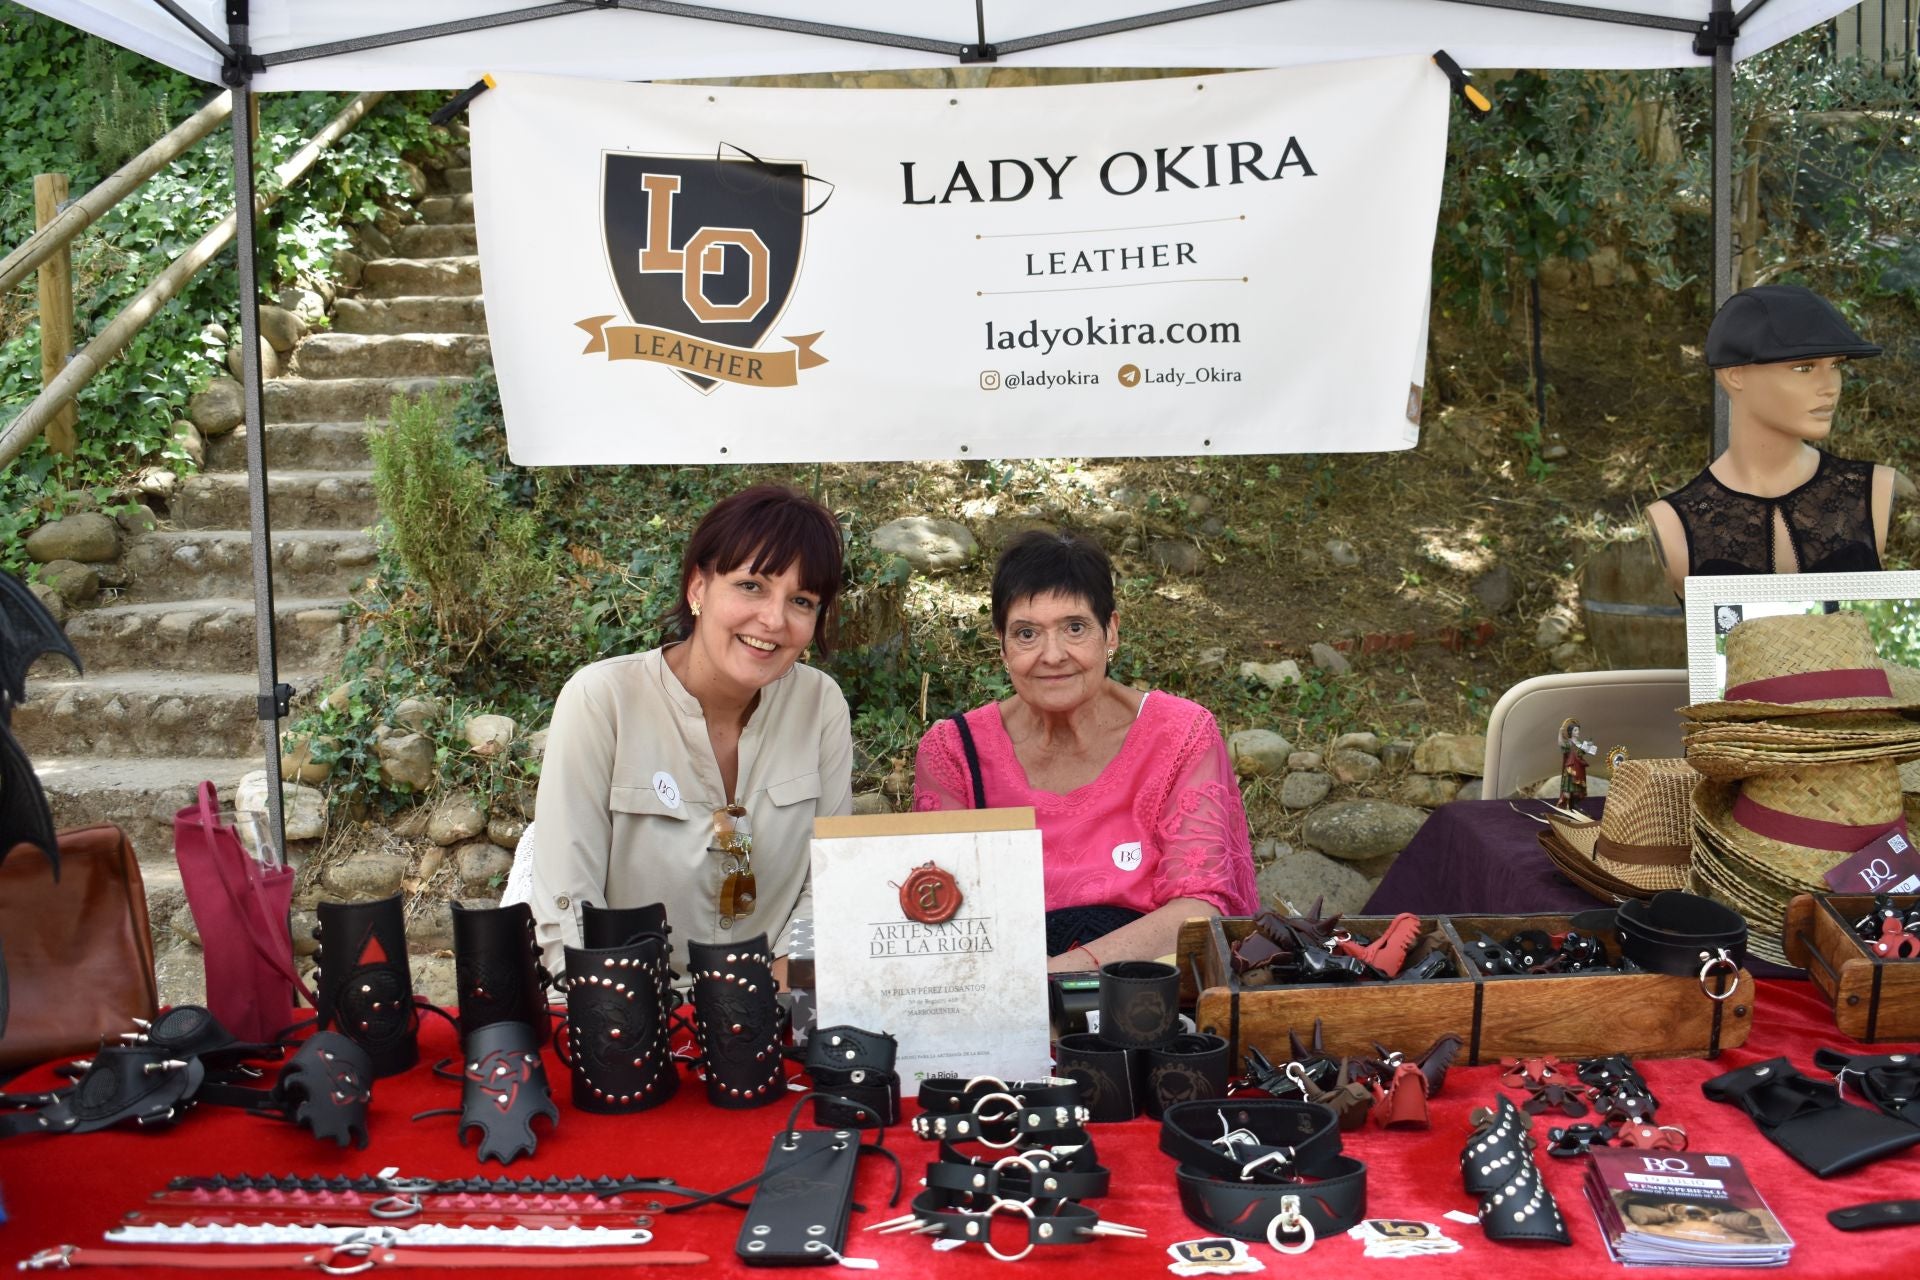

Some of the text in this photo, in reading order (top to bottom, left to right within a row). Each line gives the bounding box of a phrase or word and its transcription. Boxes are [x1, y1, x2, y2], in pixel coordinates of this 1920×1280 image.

[900, 135, 1318, 205] LADY OKIRA
[1025, 241, 1198, 276] LEATHER
[985, 315, 1242, 356] ladyokira.com
[634, 333, 764, 381] LEATHER
[1004, 370, 1099, 390] @ladyokira
[1145, 366, 1242, 387] Lady_Okira
[870, 936, 994, 956] DE LA RIOJA
[893, 987, 916, 997] PILAR
[918, 985, 942, 995] PÉREZ
